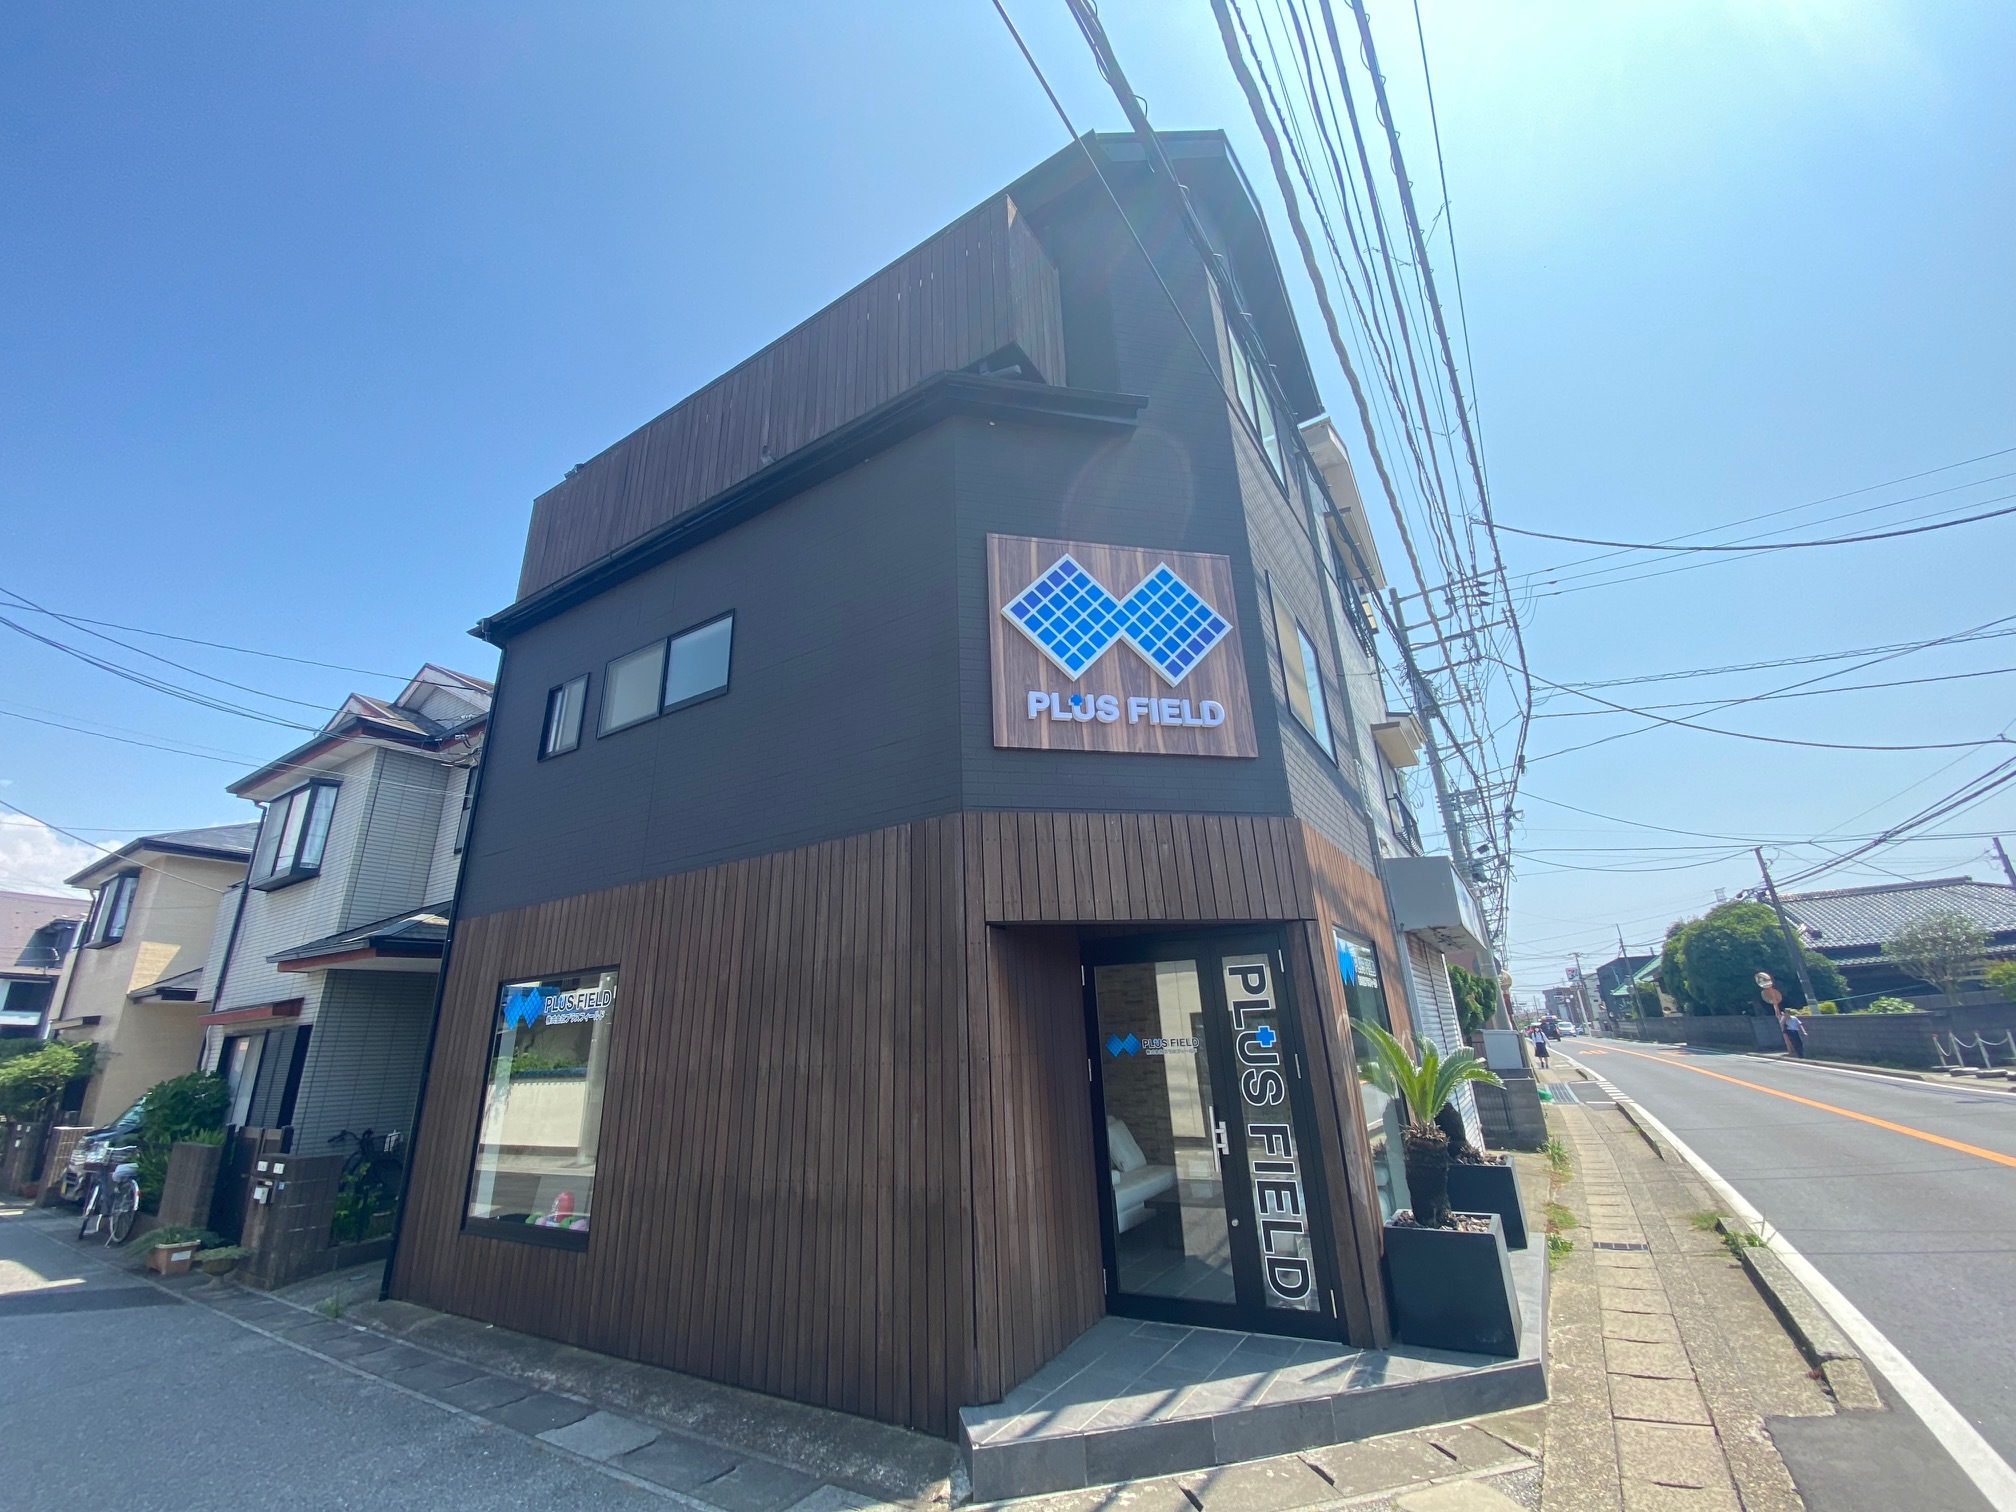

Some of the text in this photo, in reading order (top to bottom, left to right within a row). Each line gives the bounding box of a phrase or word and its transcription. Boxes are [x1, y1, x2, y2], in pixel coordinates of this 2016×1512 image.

[1027, 690, 1225, 727] PLUS FIELD
[544, 989, 612, 1013] PLUS FIELD
[1141, 1037, 1200, 1049] PLUS FIELD
[1226, 964, 1312, 1300] PLUS FIELD
